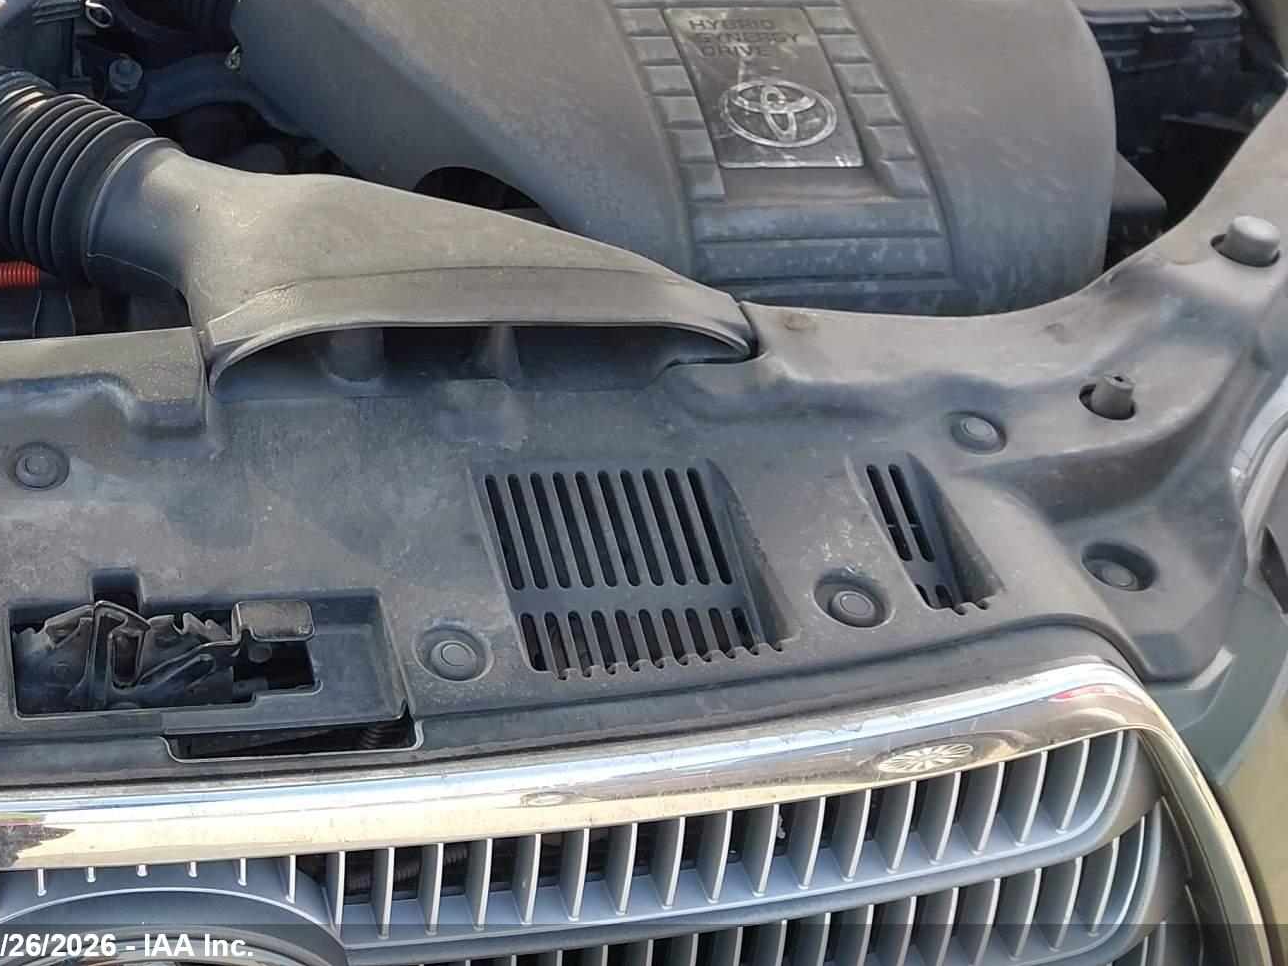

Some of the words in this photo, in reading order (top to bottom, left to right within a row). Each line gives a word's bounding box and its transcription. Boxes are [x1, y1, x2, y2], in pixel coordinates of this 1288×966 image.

[688, 19, 775, 30] HYBRID
[695, 32, 799, 43] SYNERGY
[700, 45, 772, 57] DRIVE
